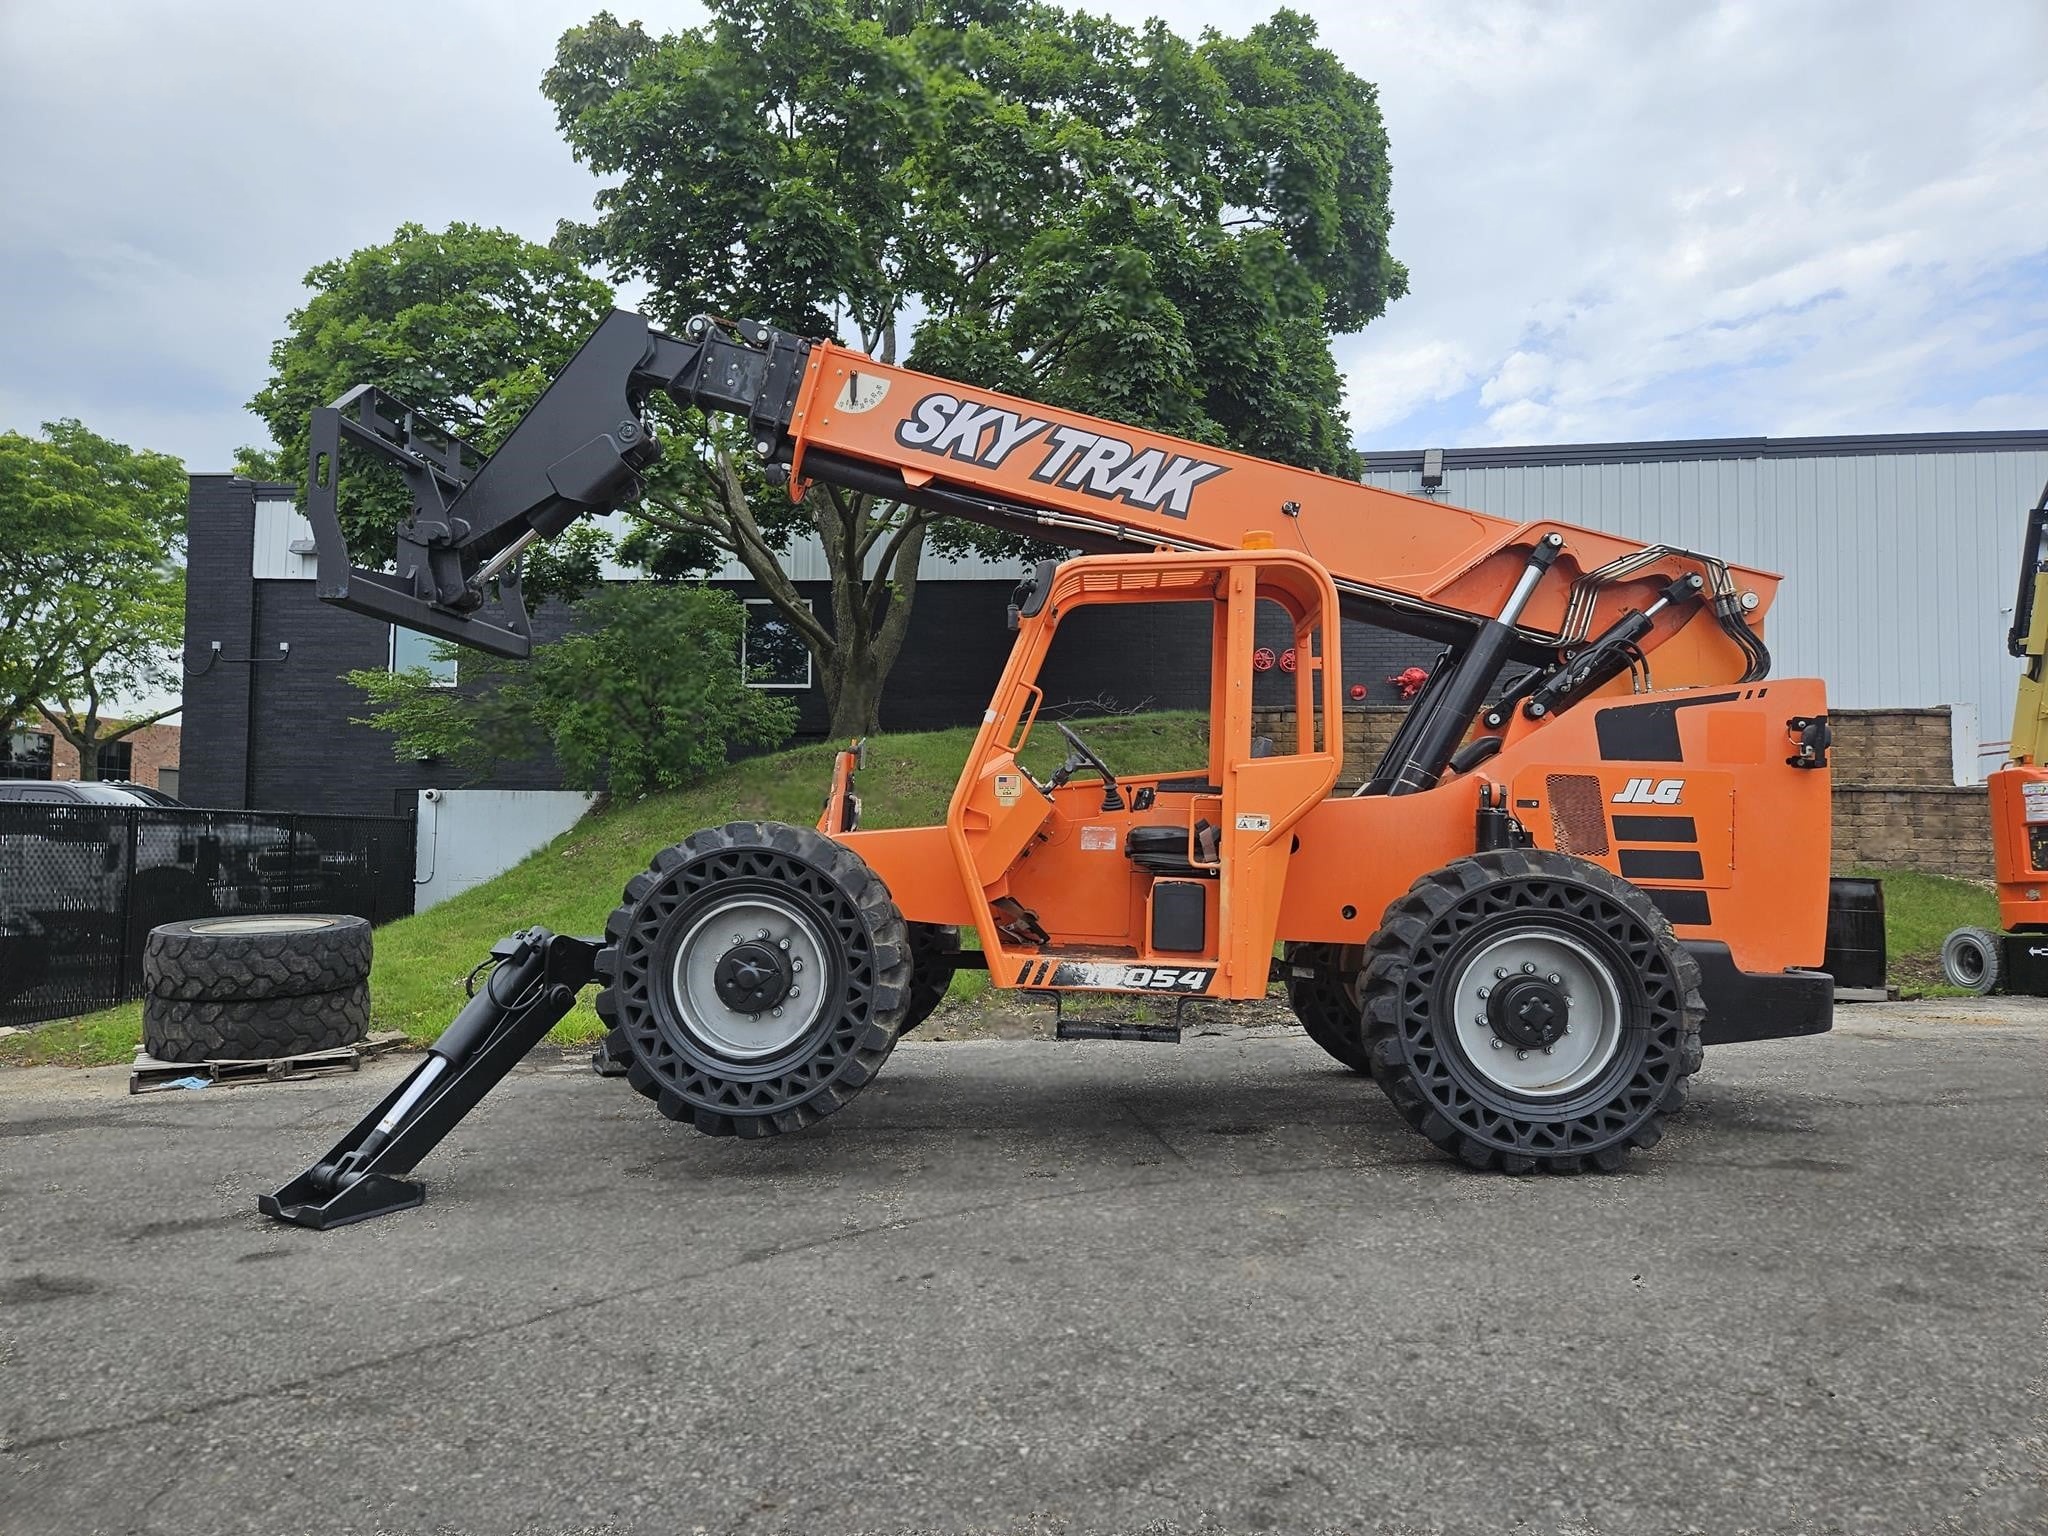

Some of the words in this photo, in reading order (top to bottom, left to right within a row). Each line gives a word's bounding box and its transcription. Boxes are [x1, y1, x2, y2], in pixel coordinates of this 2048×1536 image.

[897, 394, 1048, 469] SKY
[1030, 423, 1231, 519] TRAK
[1611, 778, 1685, 804] JLG
